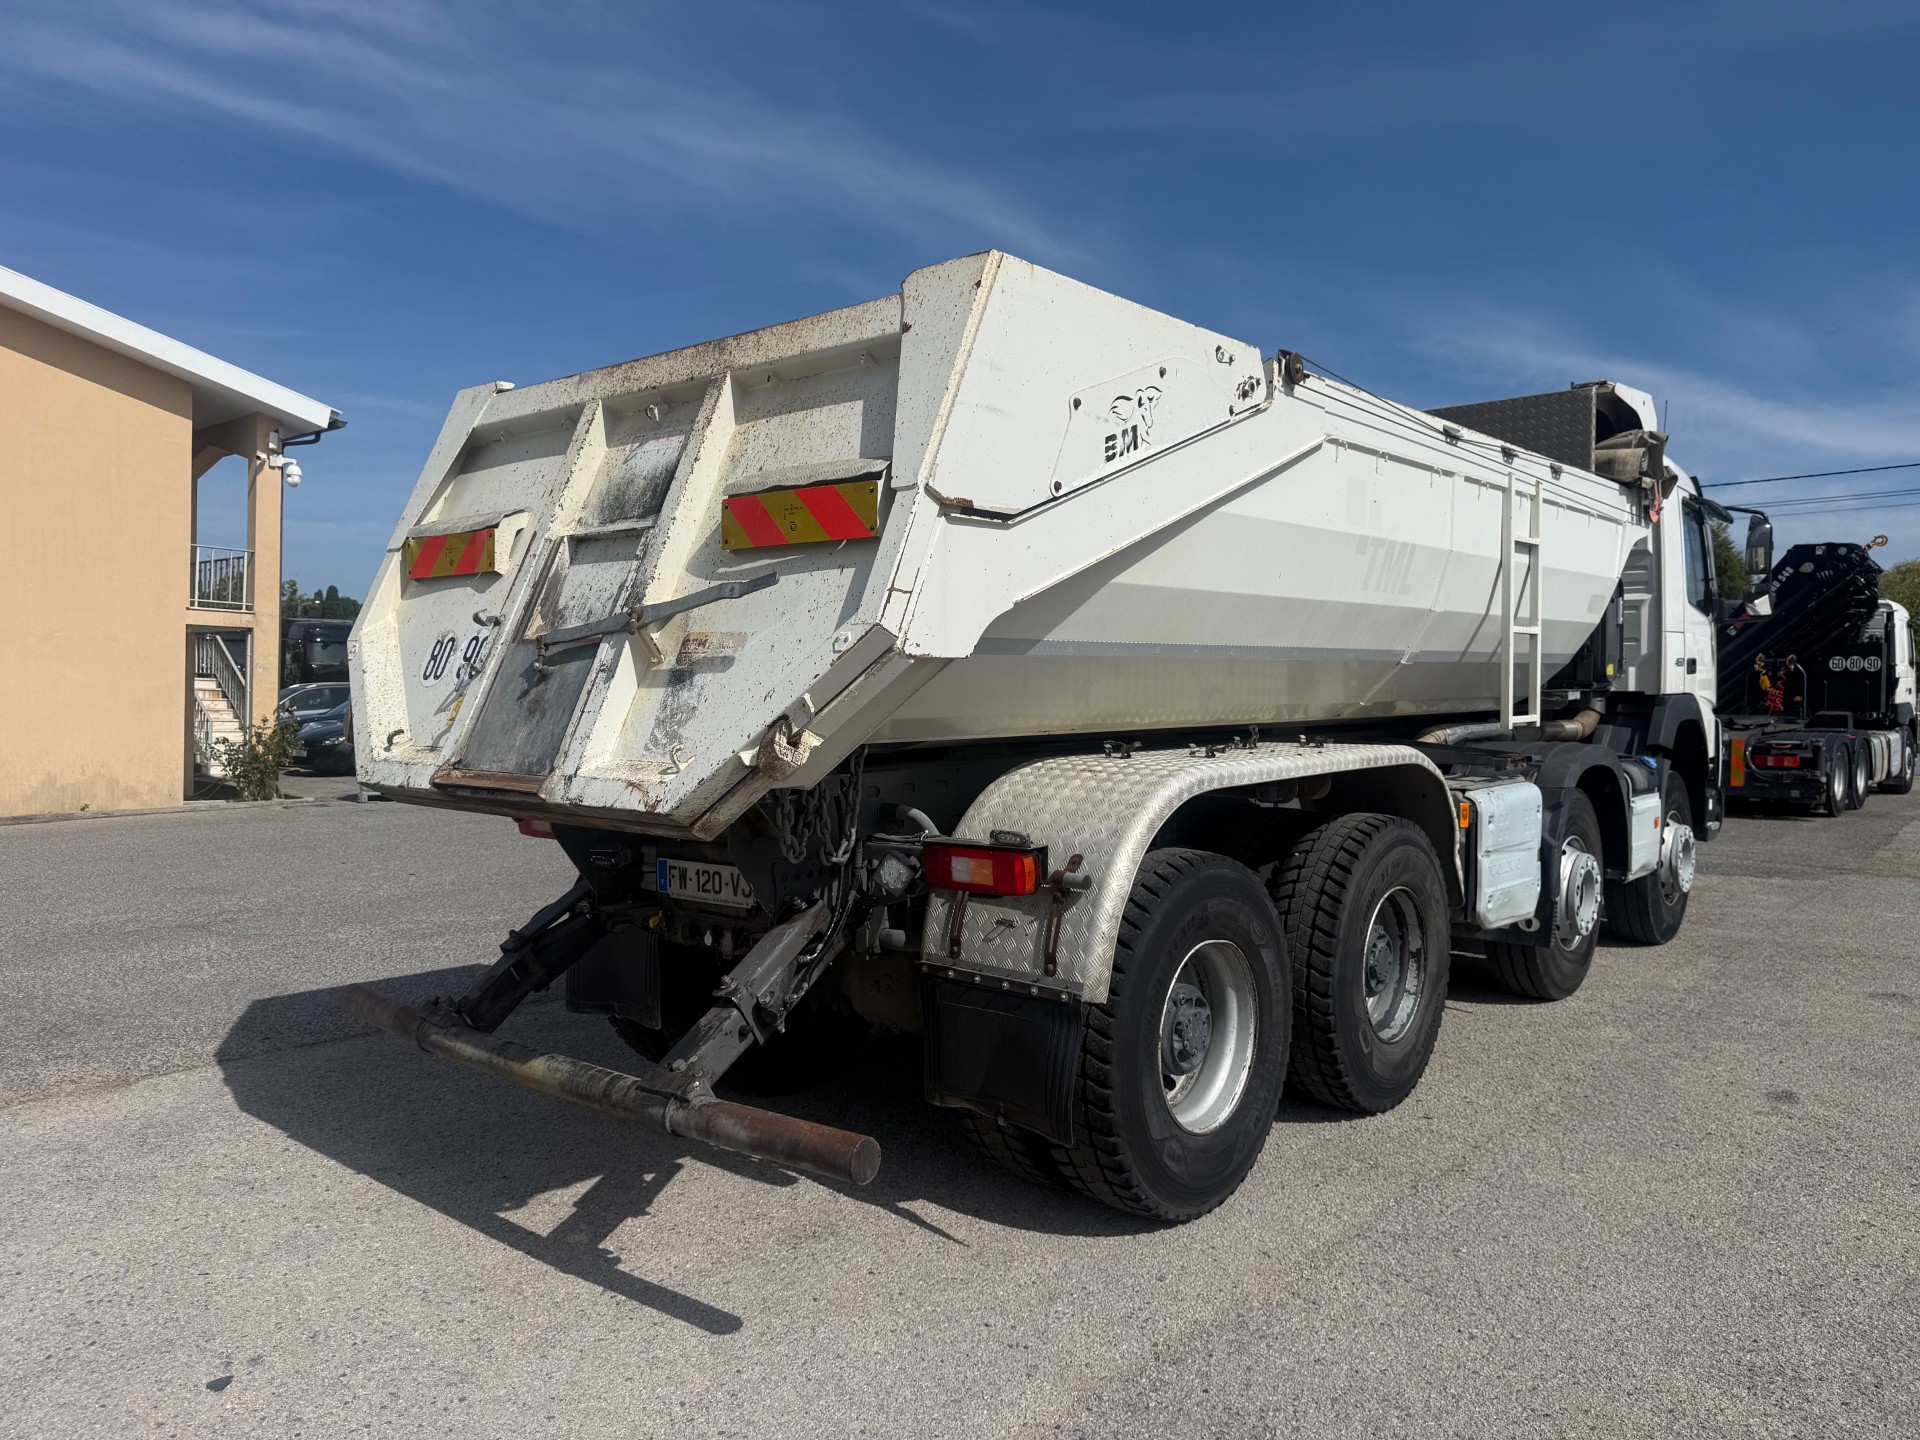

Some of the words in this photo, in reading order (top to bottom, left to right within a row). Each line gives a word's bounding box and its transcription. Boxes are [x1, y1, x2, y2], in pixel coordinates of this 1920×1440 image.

[1104, 424, 1139, 463] BM
[423, 637, 456, 681] 80
[1831, 657, 1844, 670] 60
[1849, 657, 1862, 670] 80
[1866, 657, 1879, 670] 90
